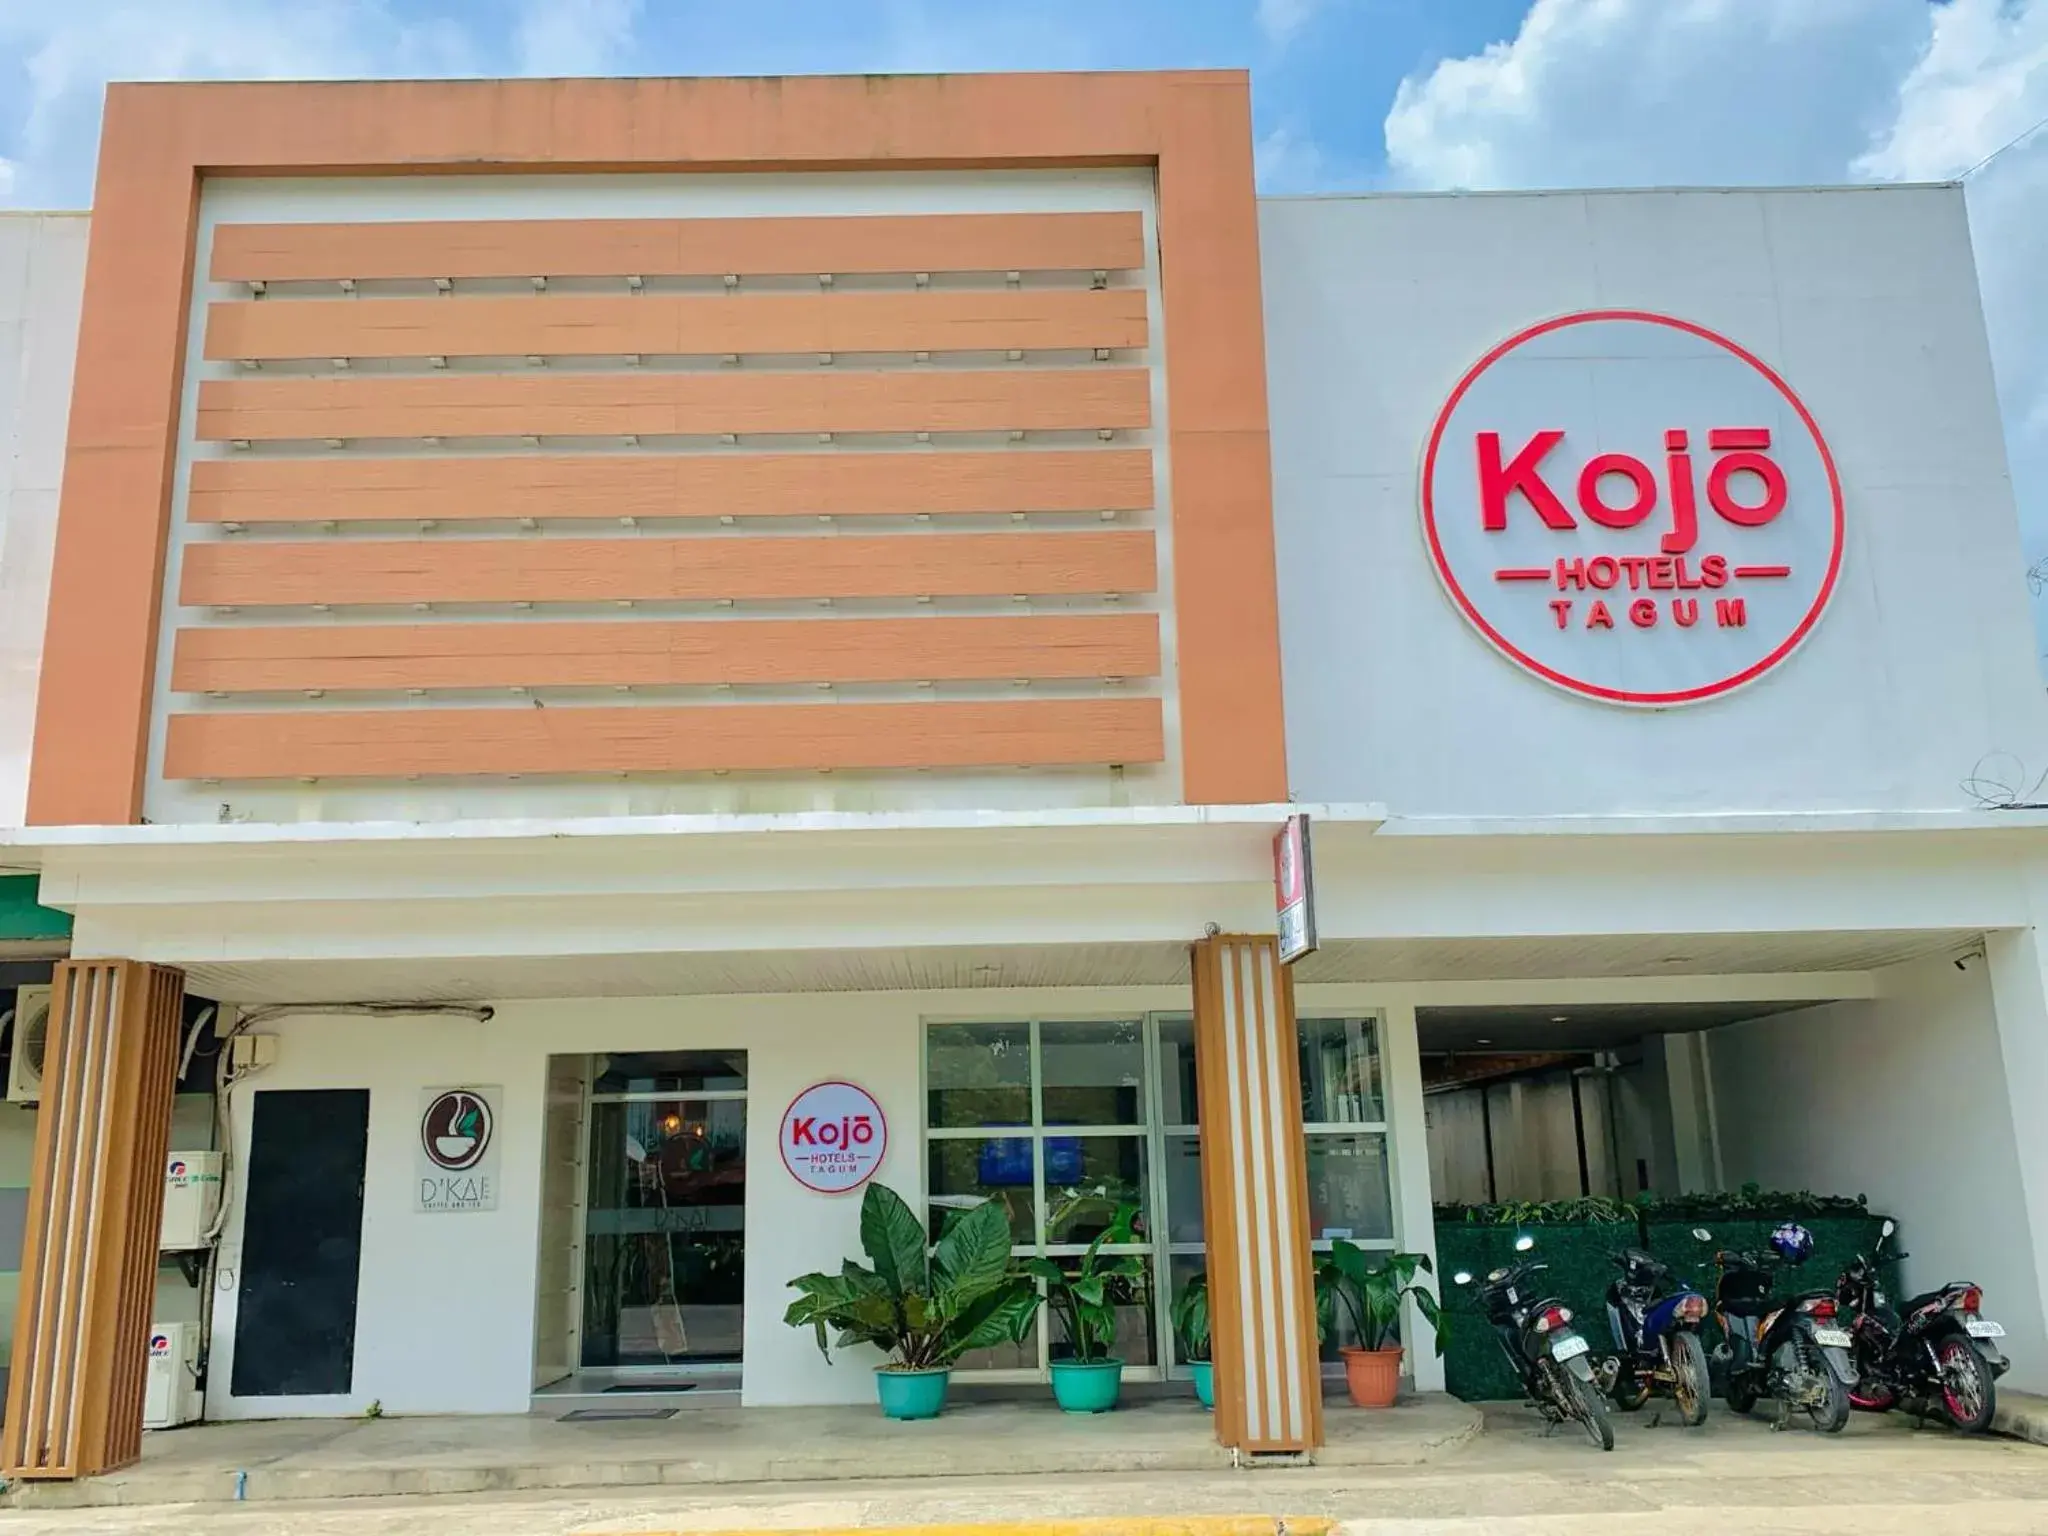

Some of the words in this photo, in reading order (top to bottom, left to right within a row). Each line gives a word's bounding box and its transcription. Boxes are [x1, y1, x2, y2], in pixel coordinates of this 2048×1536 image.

[1475, 428, 1788, 555] Kojō
[1555, 555, 1730, 591] HOTELS
[1549, 598, 1747, 629] TAGUM
[793, 1116, 873, 1150] Kojō
[810, 1165, 857, 1173] TAGUM
[811, 1153, 856, 1164] HOTELS
